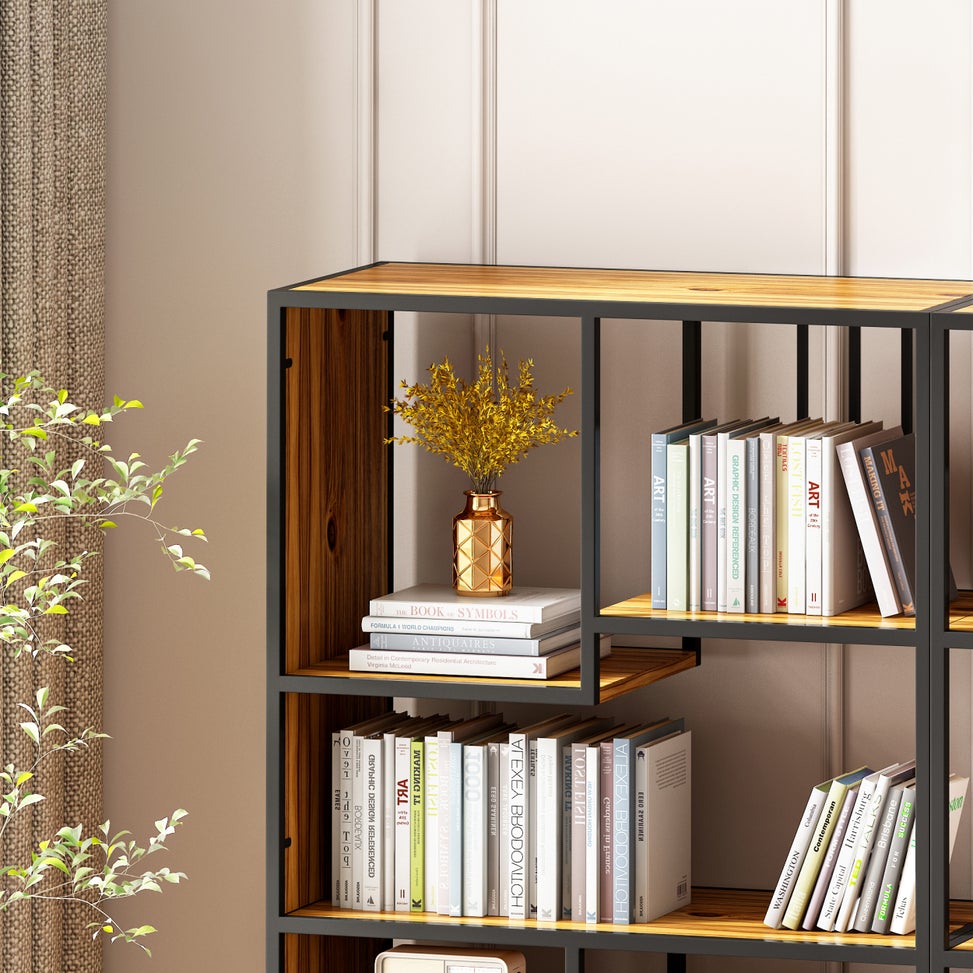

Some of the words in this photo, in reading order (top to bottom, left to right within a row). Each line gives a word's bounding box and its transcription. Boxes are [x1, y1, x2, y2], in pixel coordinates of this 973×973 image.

[654, 476, 664, 502] ART
[864, 456, 881, 498] MAKING
[704, 478, 715, 504] ART
[808, 481, 820, 508] ART
[410, 606, 444, 617] BOOK
[458, 608, 518, 620] SYMBOLS
[370, 622, 396, 630] FORMULA
[422, 624, 454, 632] CHAMPIONS
[412, 637, 496, 650] ANTIQUAIRES
[845, 791, 872, 848] Harrisburg
[878, 800, 897, 847] Brisbane
[879, 883, 893, 920] FORMULA
[898, 801, 912, 838] SUCCESS
[773, 851, 800, 910] WASHINGTON
